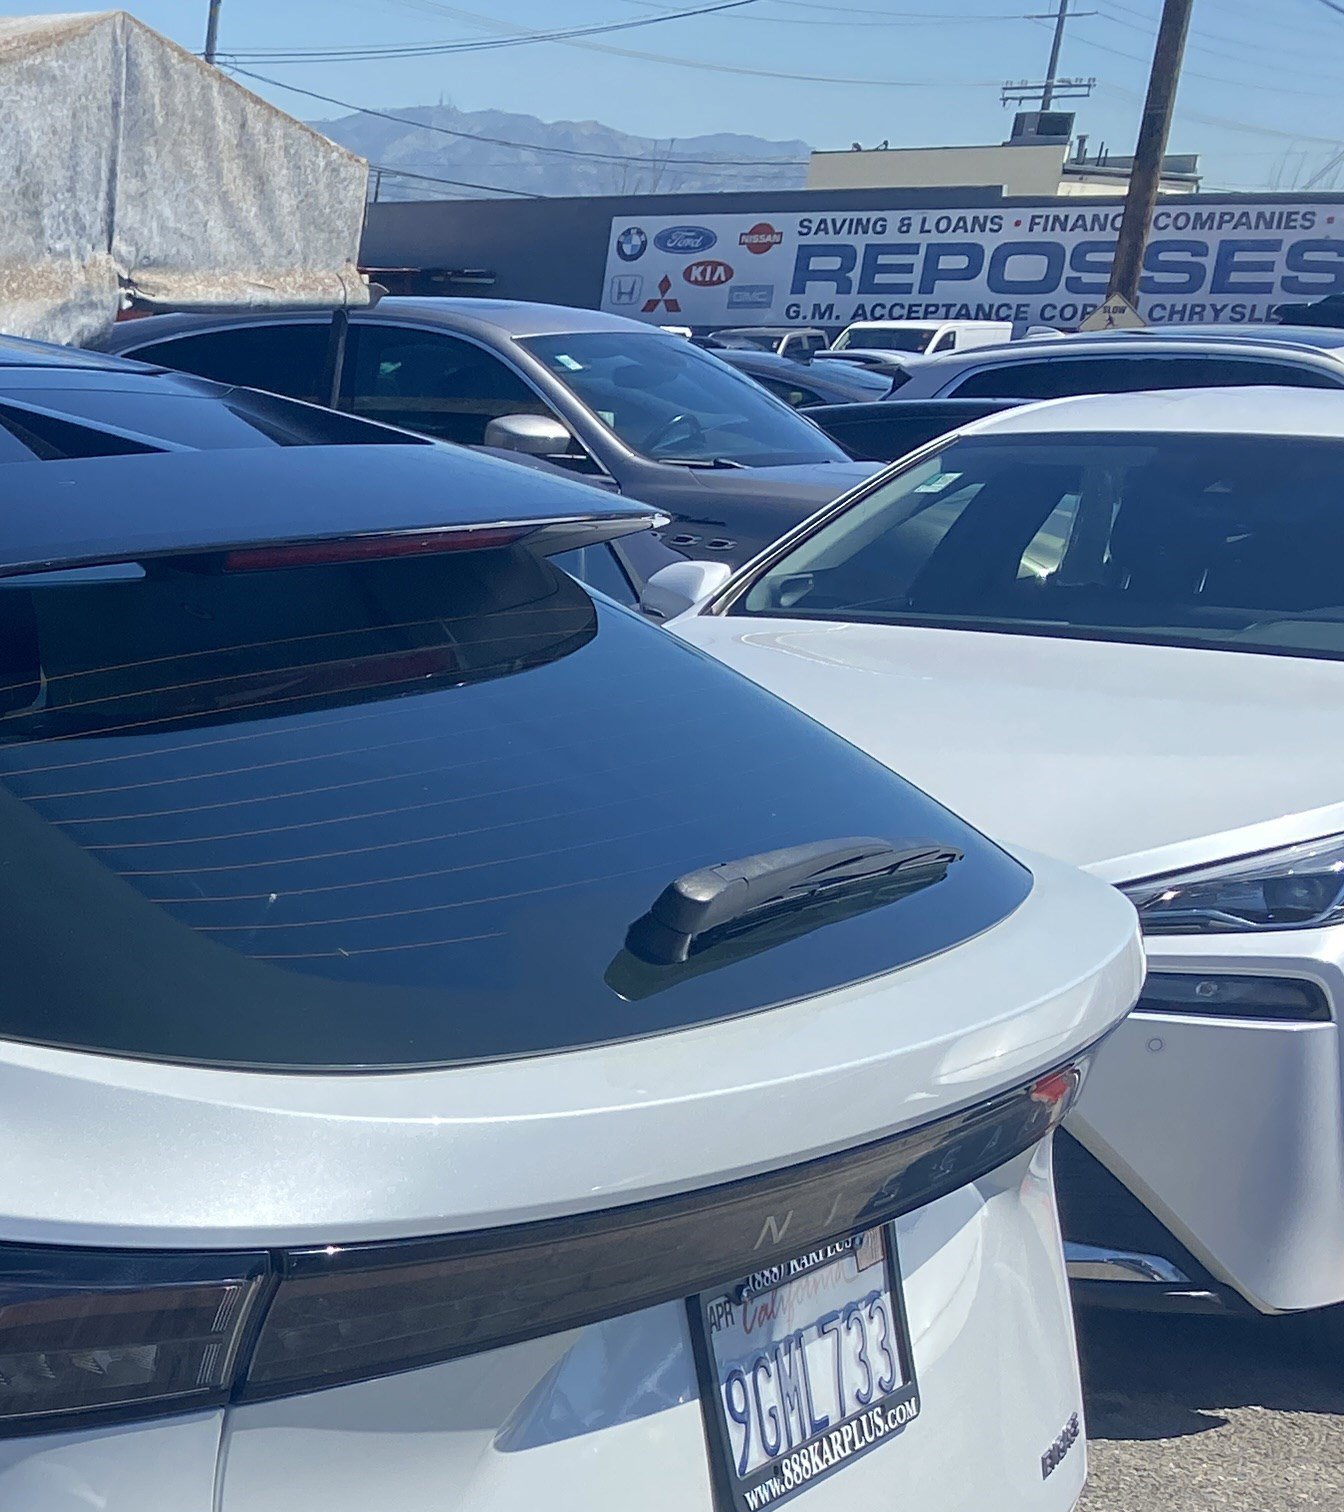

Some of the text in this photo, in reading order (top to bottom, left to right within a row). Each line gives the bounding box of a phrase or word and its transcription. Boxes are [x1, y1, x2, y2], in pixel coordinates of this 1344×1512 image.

[797, 211, 1317, 237] SAVING & LOANS FINANC COMPANIES
[666, 231, 703, 248] Ford
[739, 233, 782, 245] NISSAN
[690, 265, 727, 282] KIA
[732, 291, 769, 302] GMC
[784, 303, 842, 322] G.M.
[850, 303, 1031, 322] ACCEPTANCE
[1148, 303, 1283, 323] CHRYSLE
[1102, 305, 1128, 315] SLOW
[742, 1257, 861, 1335] California
[709, 1299, 736, 1336] APR
[725, 1294, 898, 1479] 9GML733
